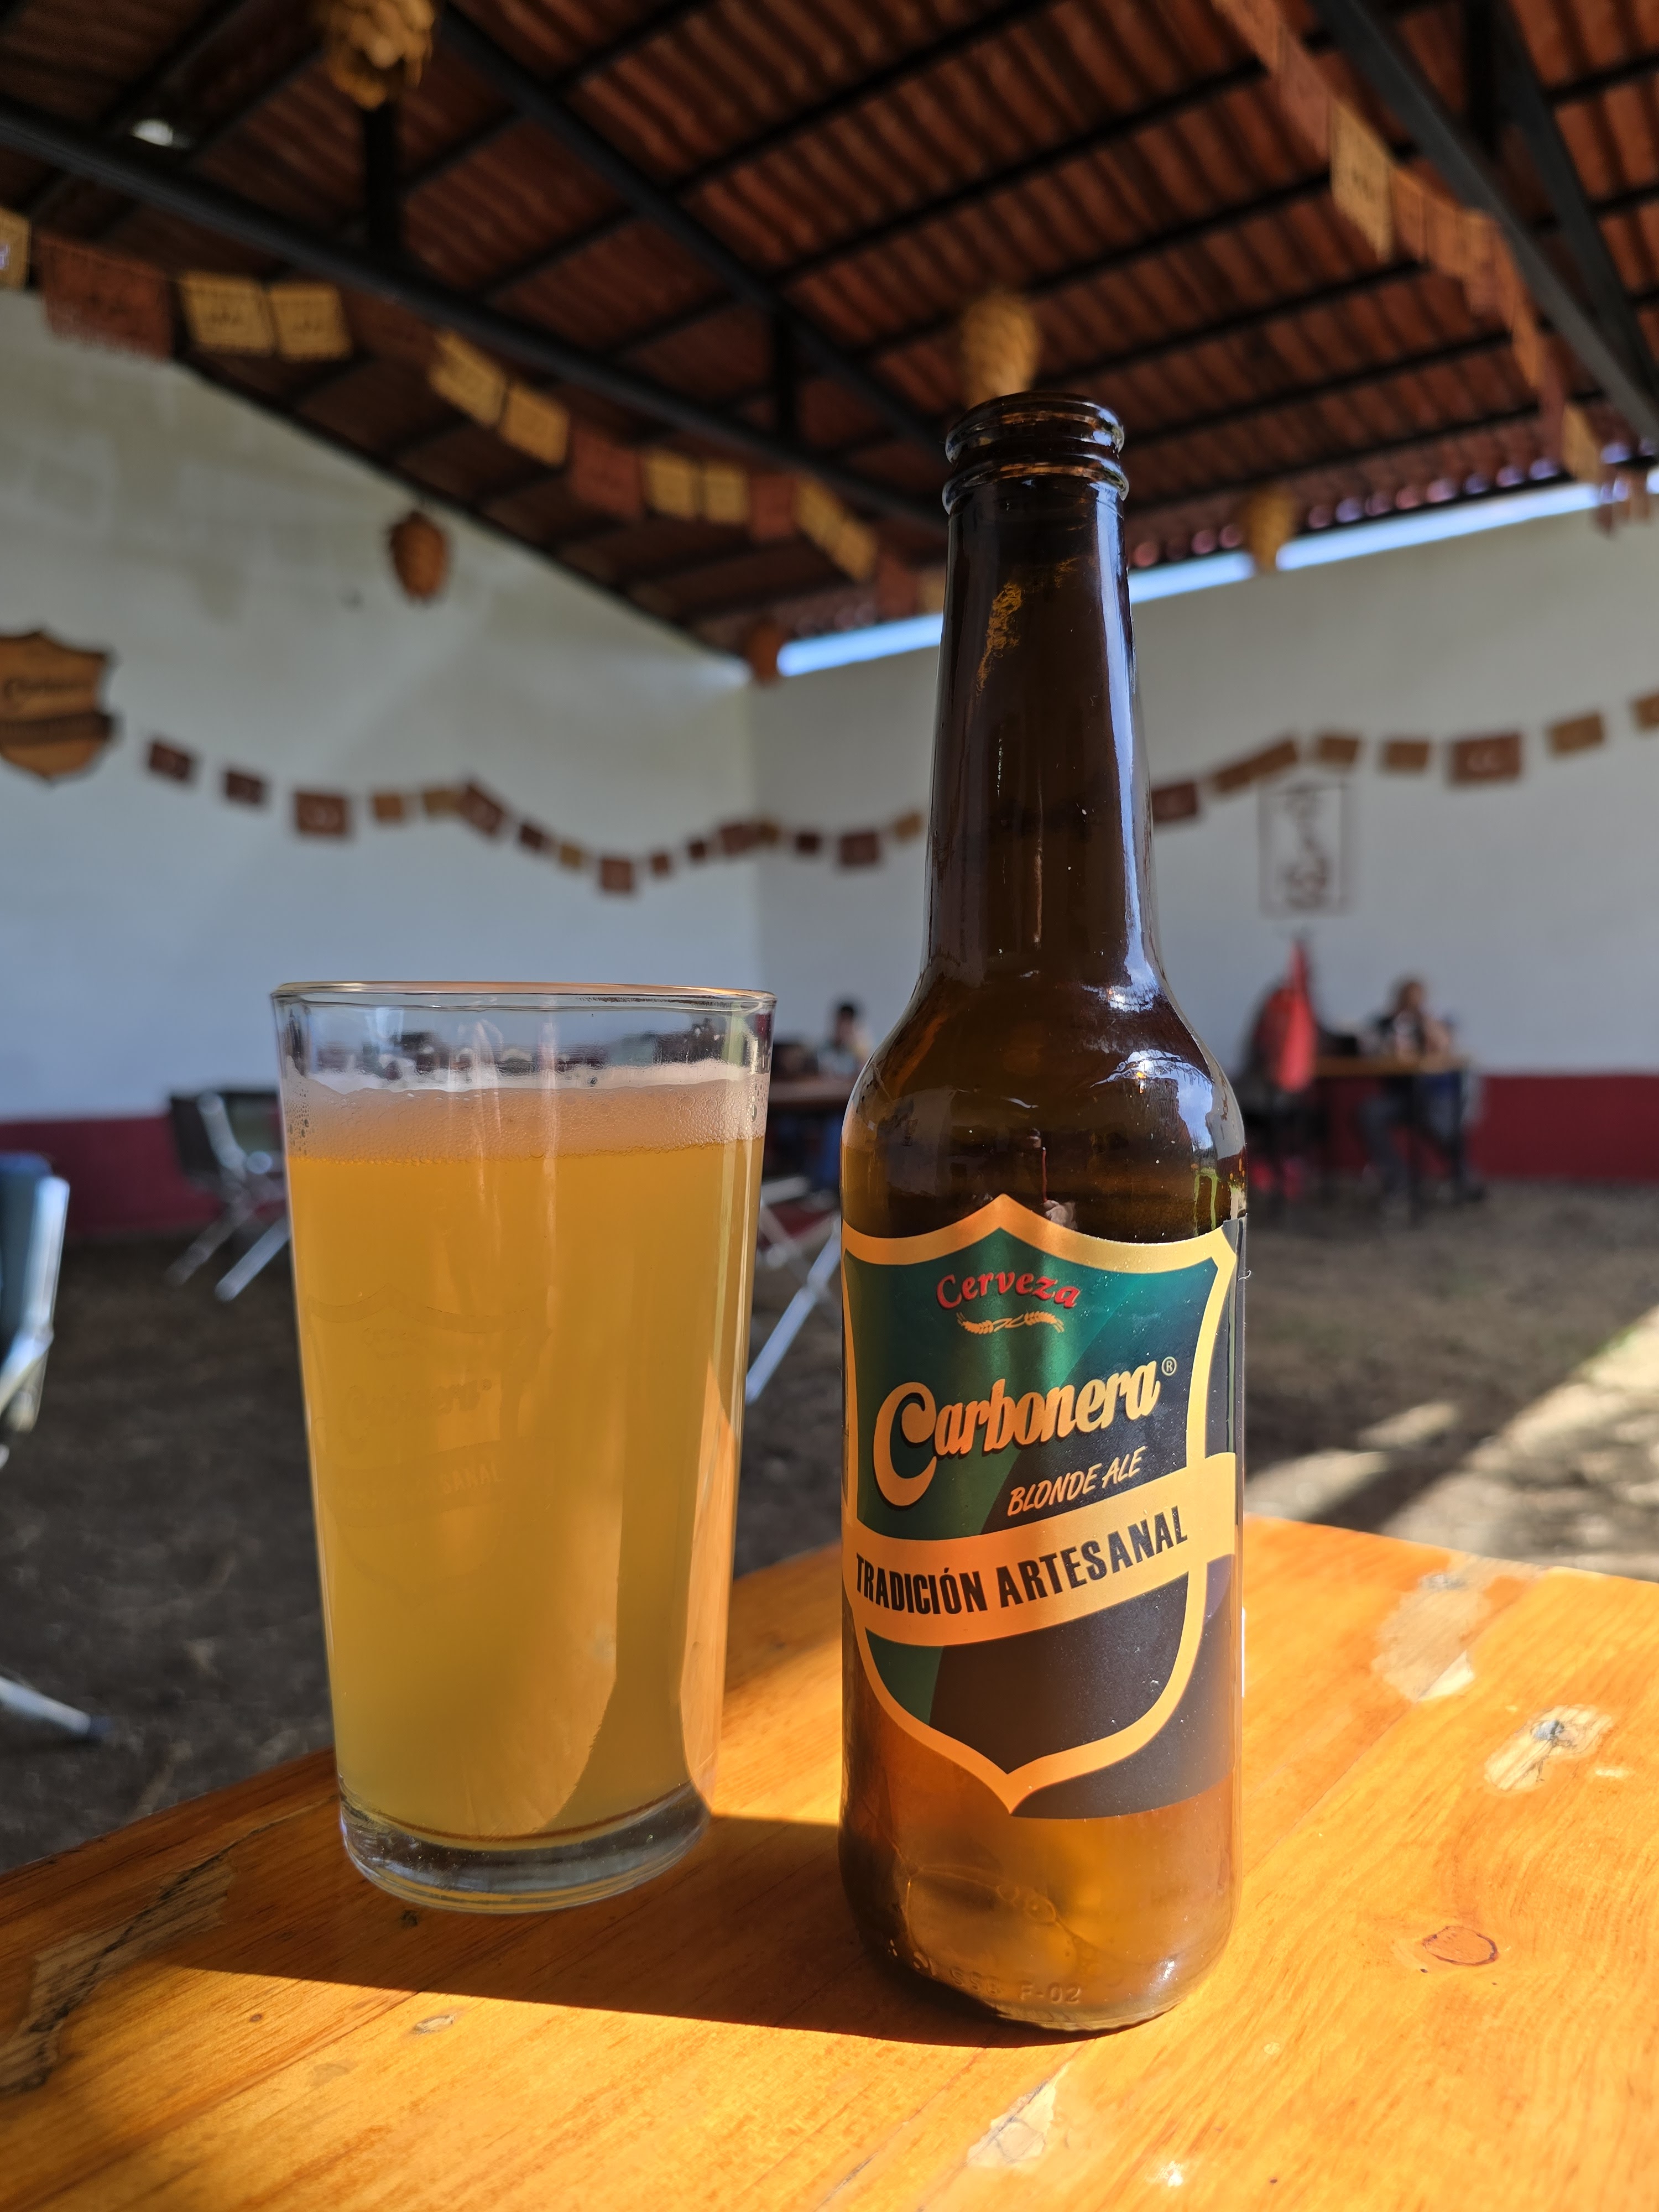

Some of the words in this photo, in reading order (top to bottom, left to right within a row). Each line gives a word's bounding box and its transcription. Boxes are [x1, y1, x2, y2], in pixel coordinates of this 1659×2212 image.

[937, 1271, 1081, 1309] Cerveza
[873, 1360, 1160, 1506] Carbonera
[1006, 1463, 1100, 1516] BLONDE
[1101, 1445, 1147, 1488] ALE
[856, 1553, 988, 1615] TRADICIÓN
[996, 1506, 1188, 1610] ARTESANAL
